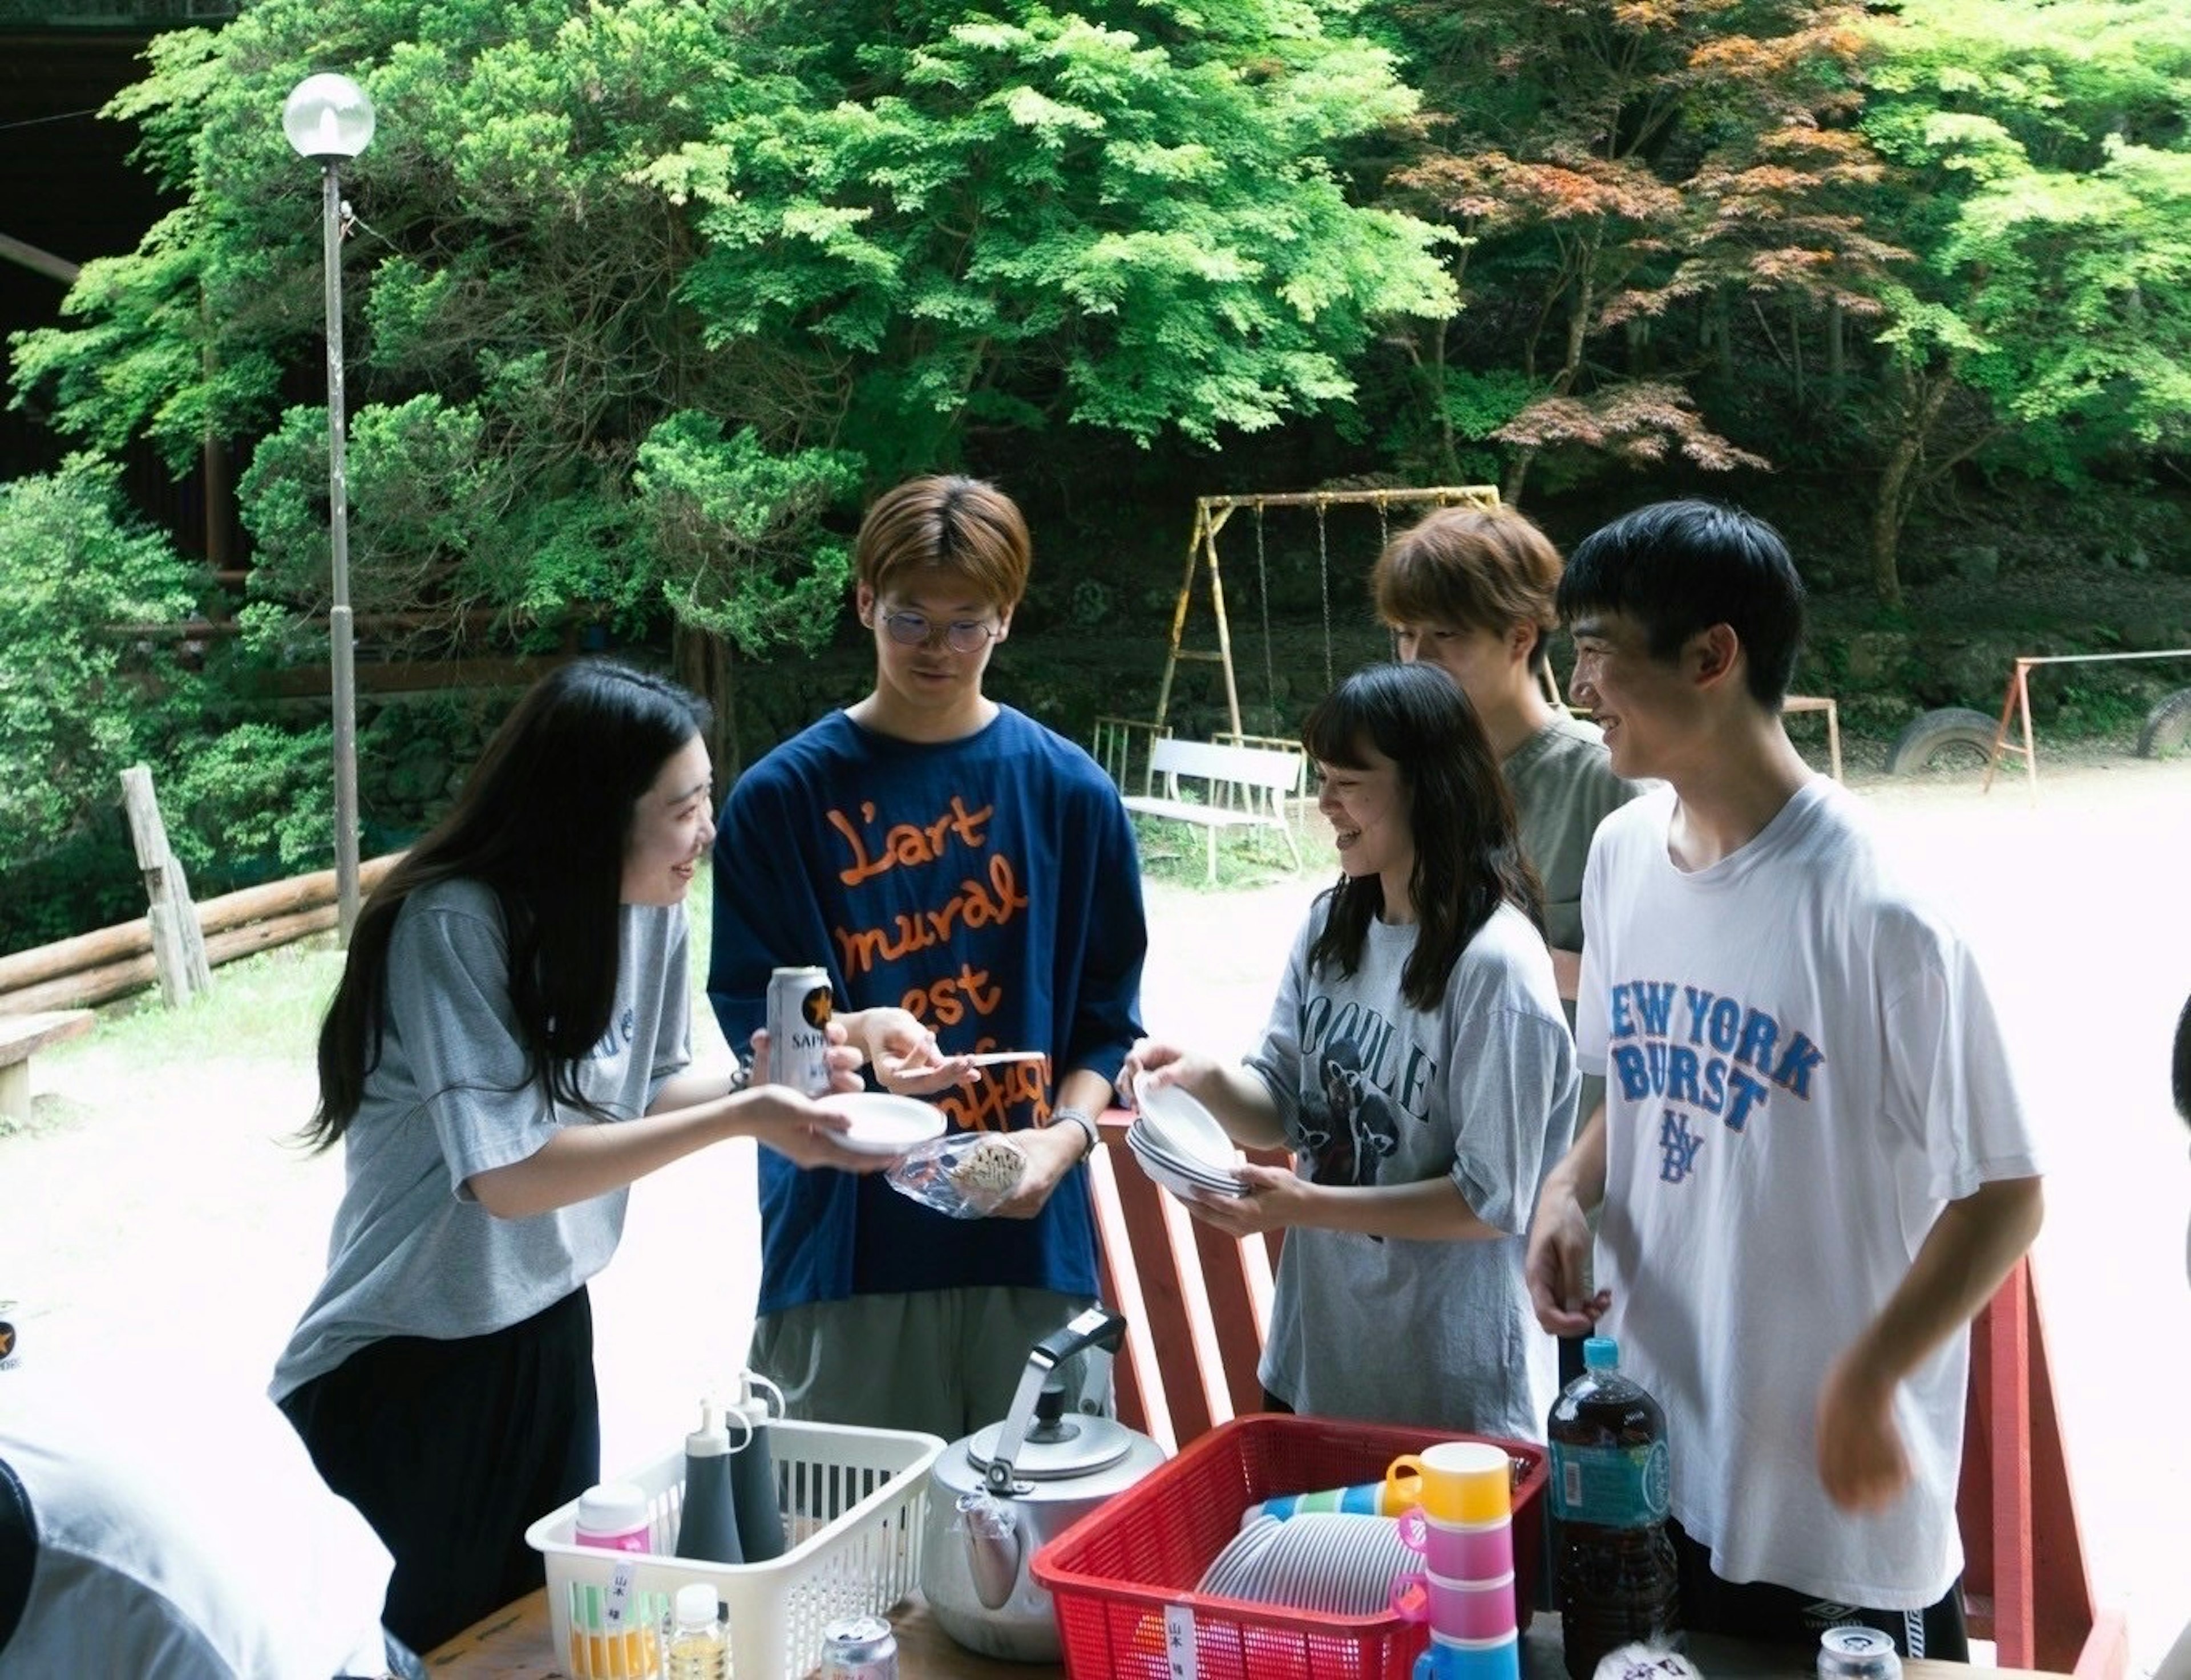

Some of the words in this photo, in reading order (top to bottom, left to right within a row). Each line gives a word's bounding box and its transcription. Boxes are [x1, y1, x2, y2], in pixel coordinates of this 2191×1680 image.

[835, 853, 1029, 983] mural
[1612, 1042, 1769, 1133] BURST
[1684, 985, 1825, 1100] YORK
